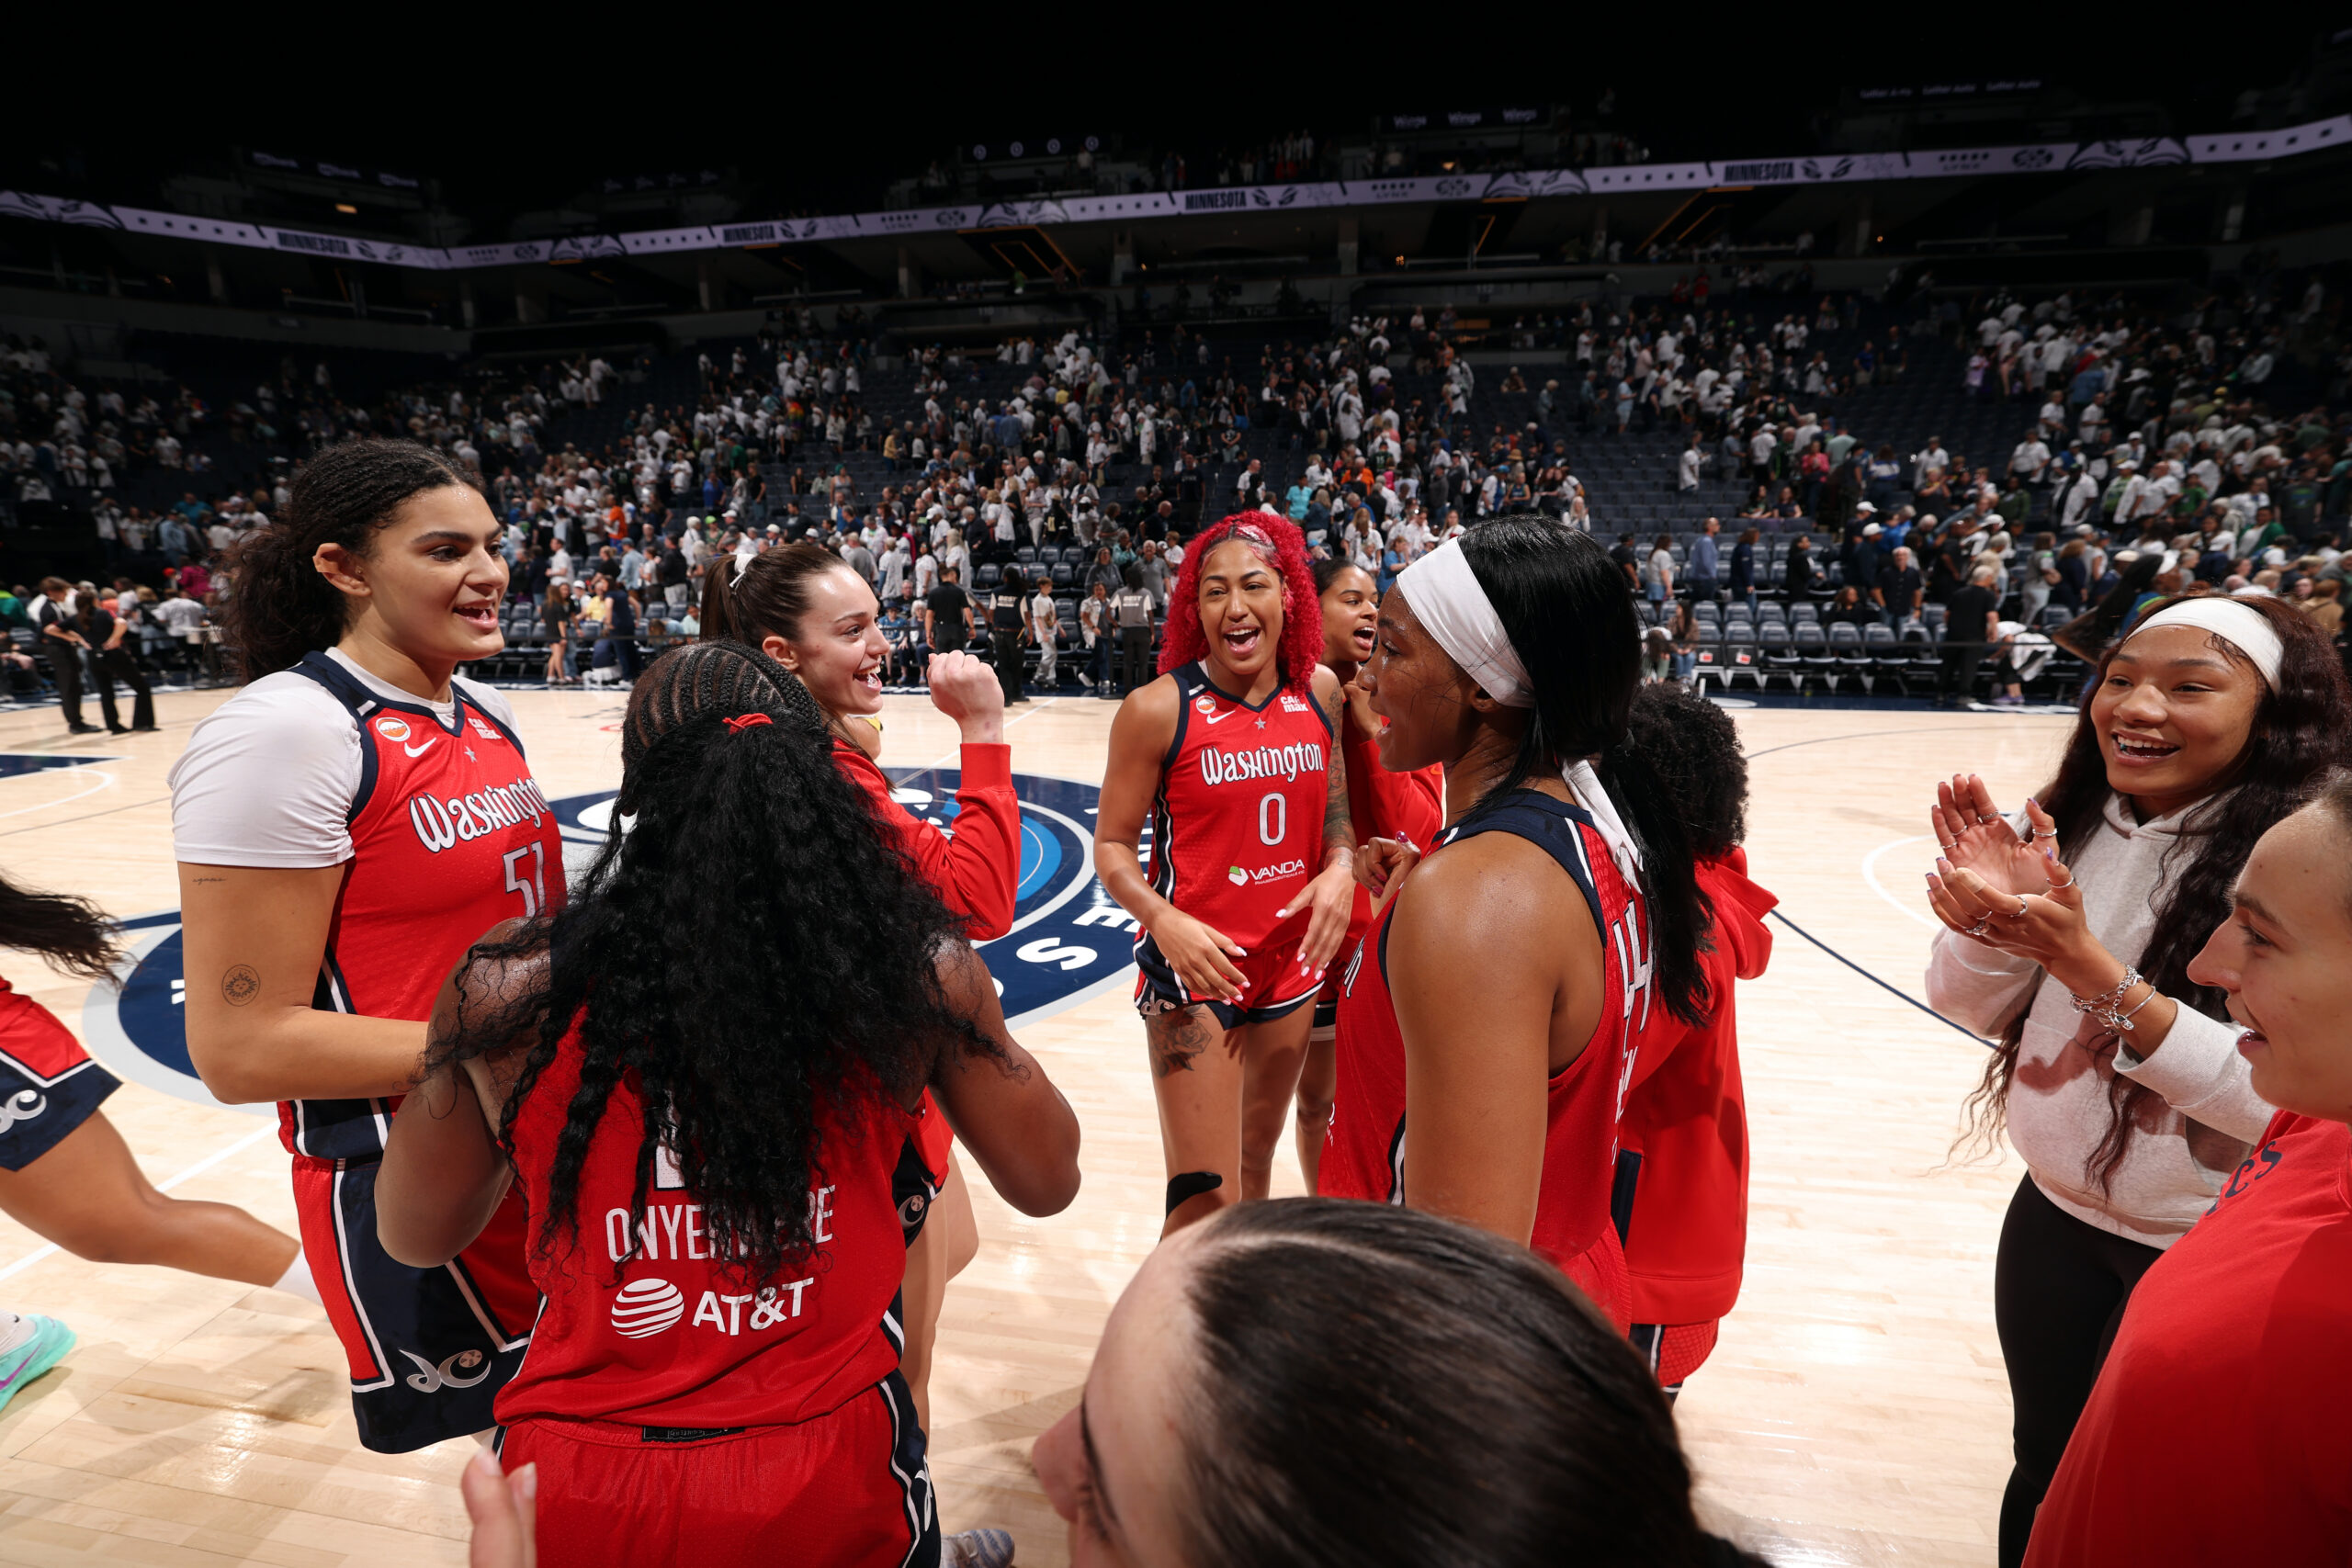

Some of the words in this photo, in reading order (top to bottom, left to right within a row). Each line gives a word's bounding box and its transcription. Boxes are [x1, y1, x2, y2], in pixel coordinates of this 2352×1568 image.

[1724, 162, 1793, 182] MINNESOTA
[1185, 191, 1246, 209] MINNESOTA
[277, 231, 349, 254] MINNESOTA
[723, 224, 775, 243] MINNESOTA
[1283, 703, 1309, 713] max
[1201, 739, 1324, 786] Washington
[410, 775, 551, 852] Washingto
[1258, 792, 1286, 847] 0
[503, 840, 547, 919] 51
[1249, 858, 1305, 880] VANDA
[605, 1184, 835, 1262] ONYERE
[691, 1277, 814, 1336] AT&T
